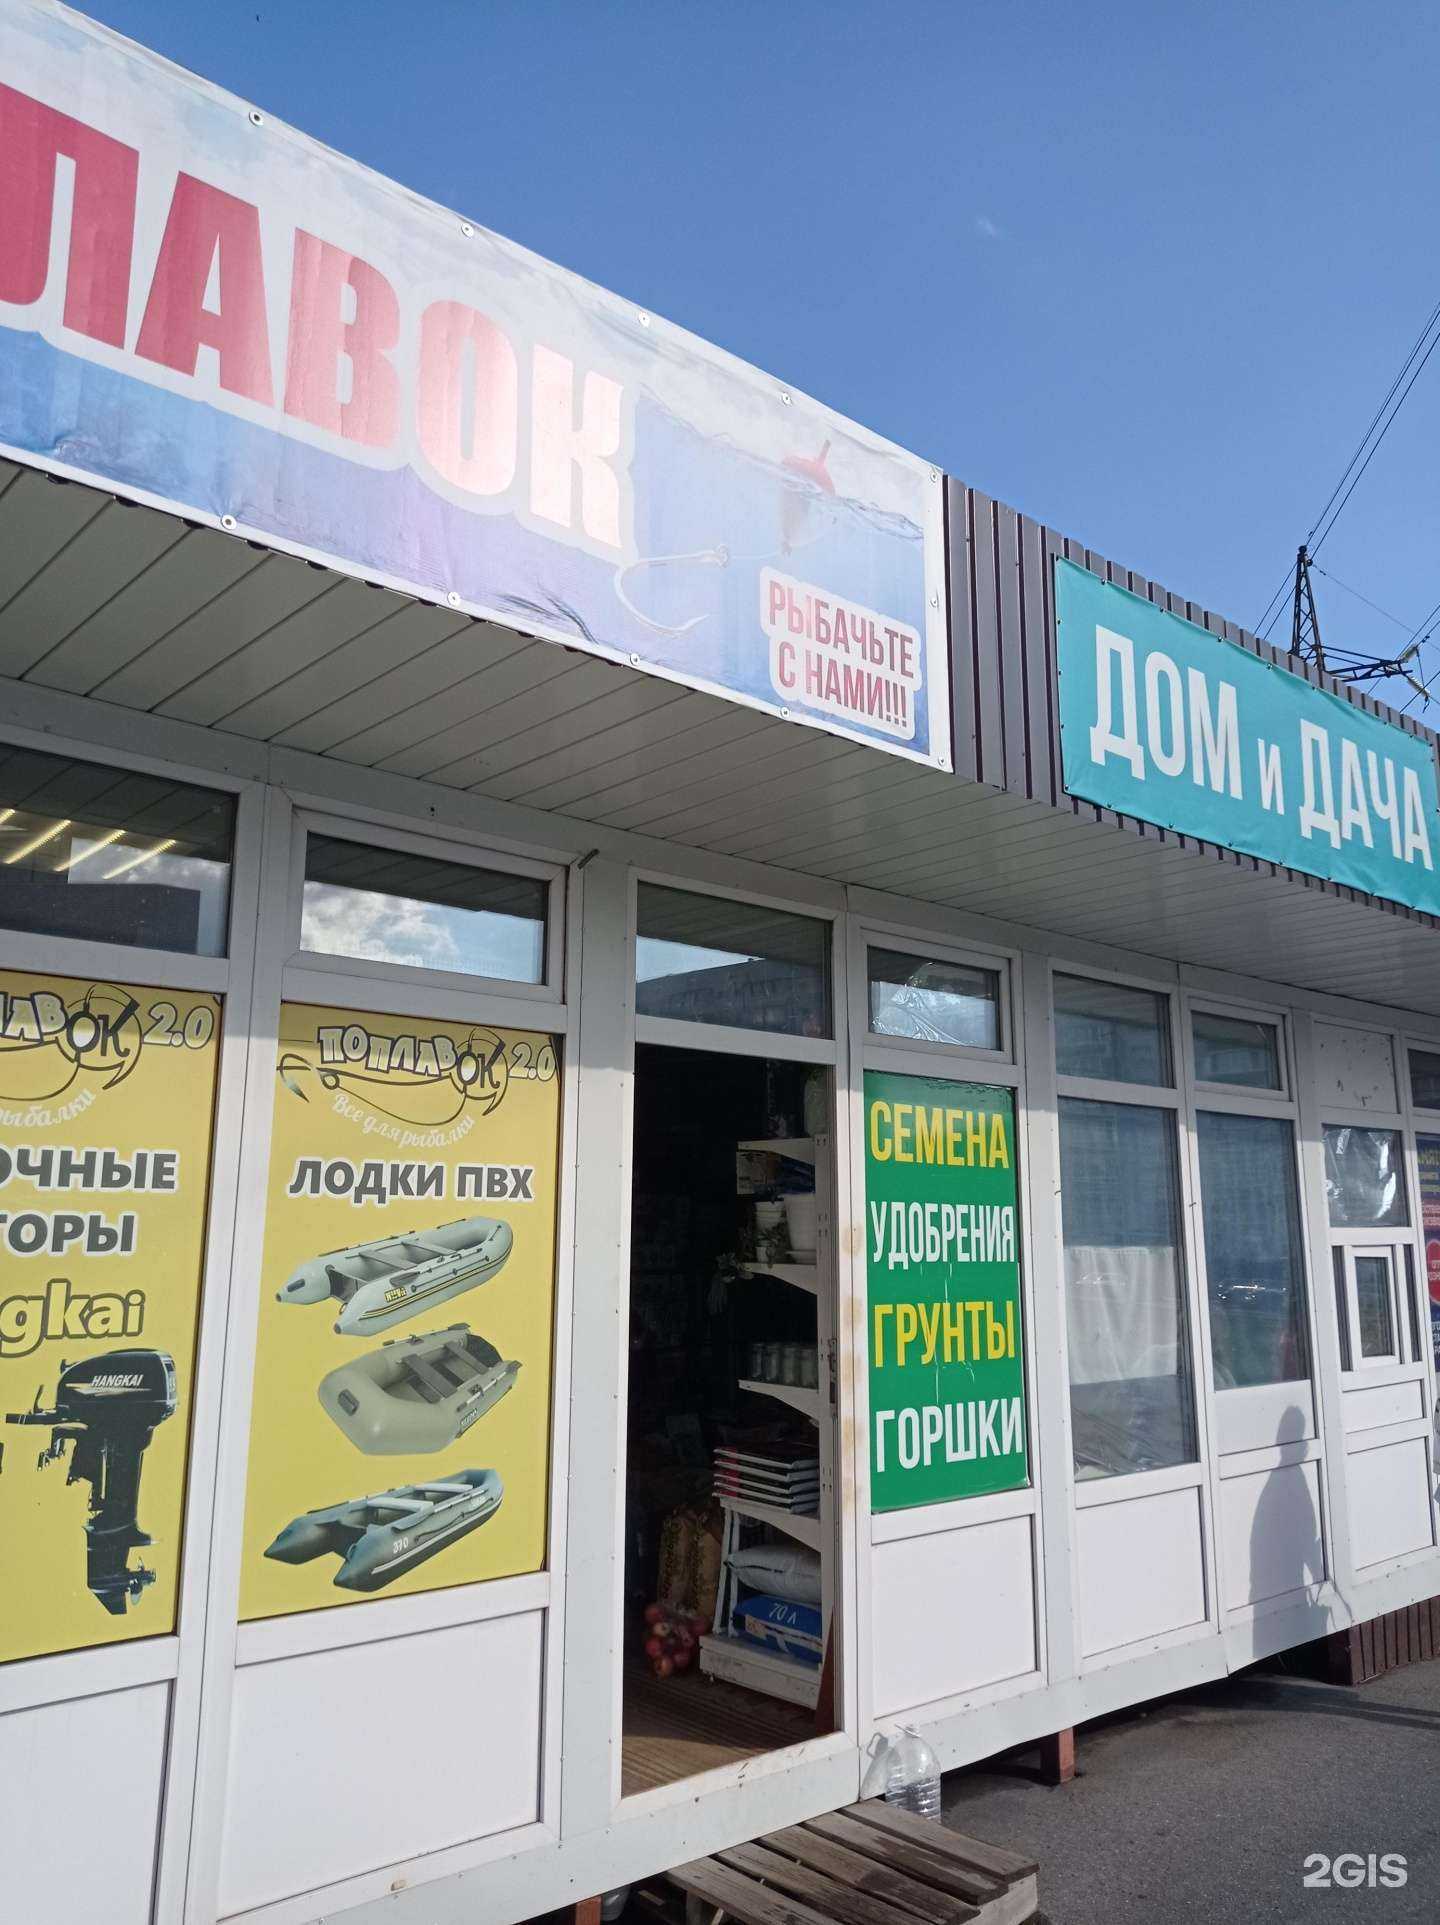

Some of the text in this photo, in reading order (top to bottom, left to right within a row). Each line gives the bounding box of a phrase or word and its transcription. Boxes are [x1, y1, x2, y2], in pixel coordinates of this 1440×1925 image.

[769, 580, 914, 678] РЫБАЧЬТЕ
[779, 641, 907, 728] С НАМИ!!!
[1089, 625, 1243, 800] ДОМ
[1299, 719, 1434, 871] ДАЧА
[143, 1001, 214, 1049] 2.0
[317, 1024, 556, 1088] ПОПЛАВОК 2.0
[331, 1093, 476, 1149] Все для рыбалки
[870, 1101, 1010, 1169] СЕМЕНА
[289, 1159, 534, 1204] ЛОДКИ ПВХ
[0, 1213, 135, 1253] ОРЫ
[870, 1201, 1016, 1270] УДОБРЕНИЯ
[874, 1301, 1016, 1368] ГРУНТЫ
[91, 1374, 144, 1387] HANGKAI
[875, 1396, 1023, 1473] ГОРШКИ
